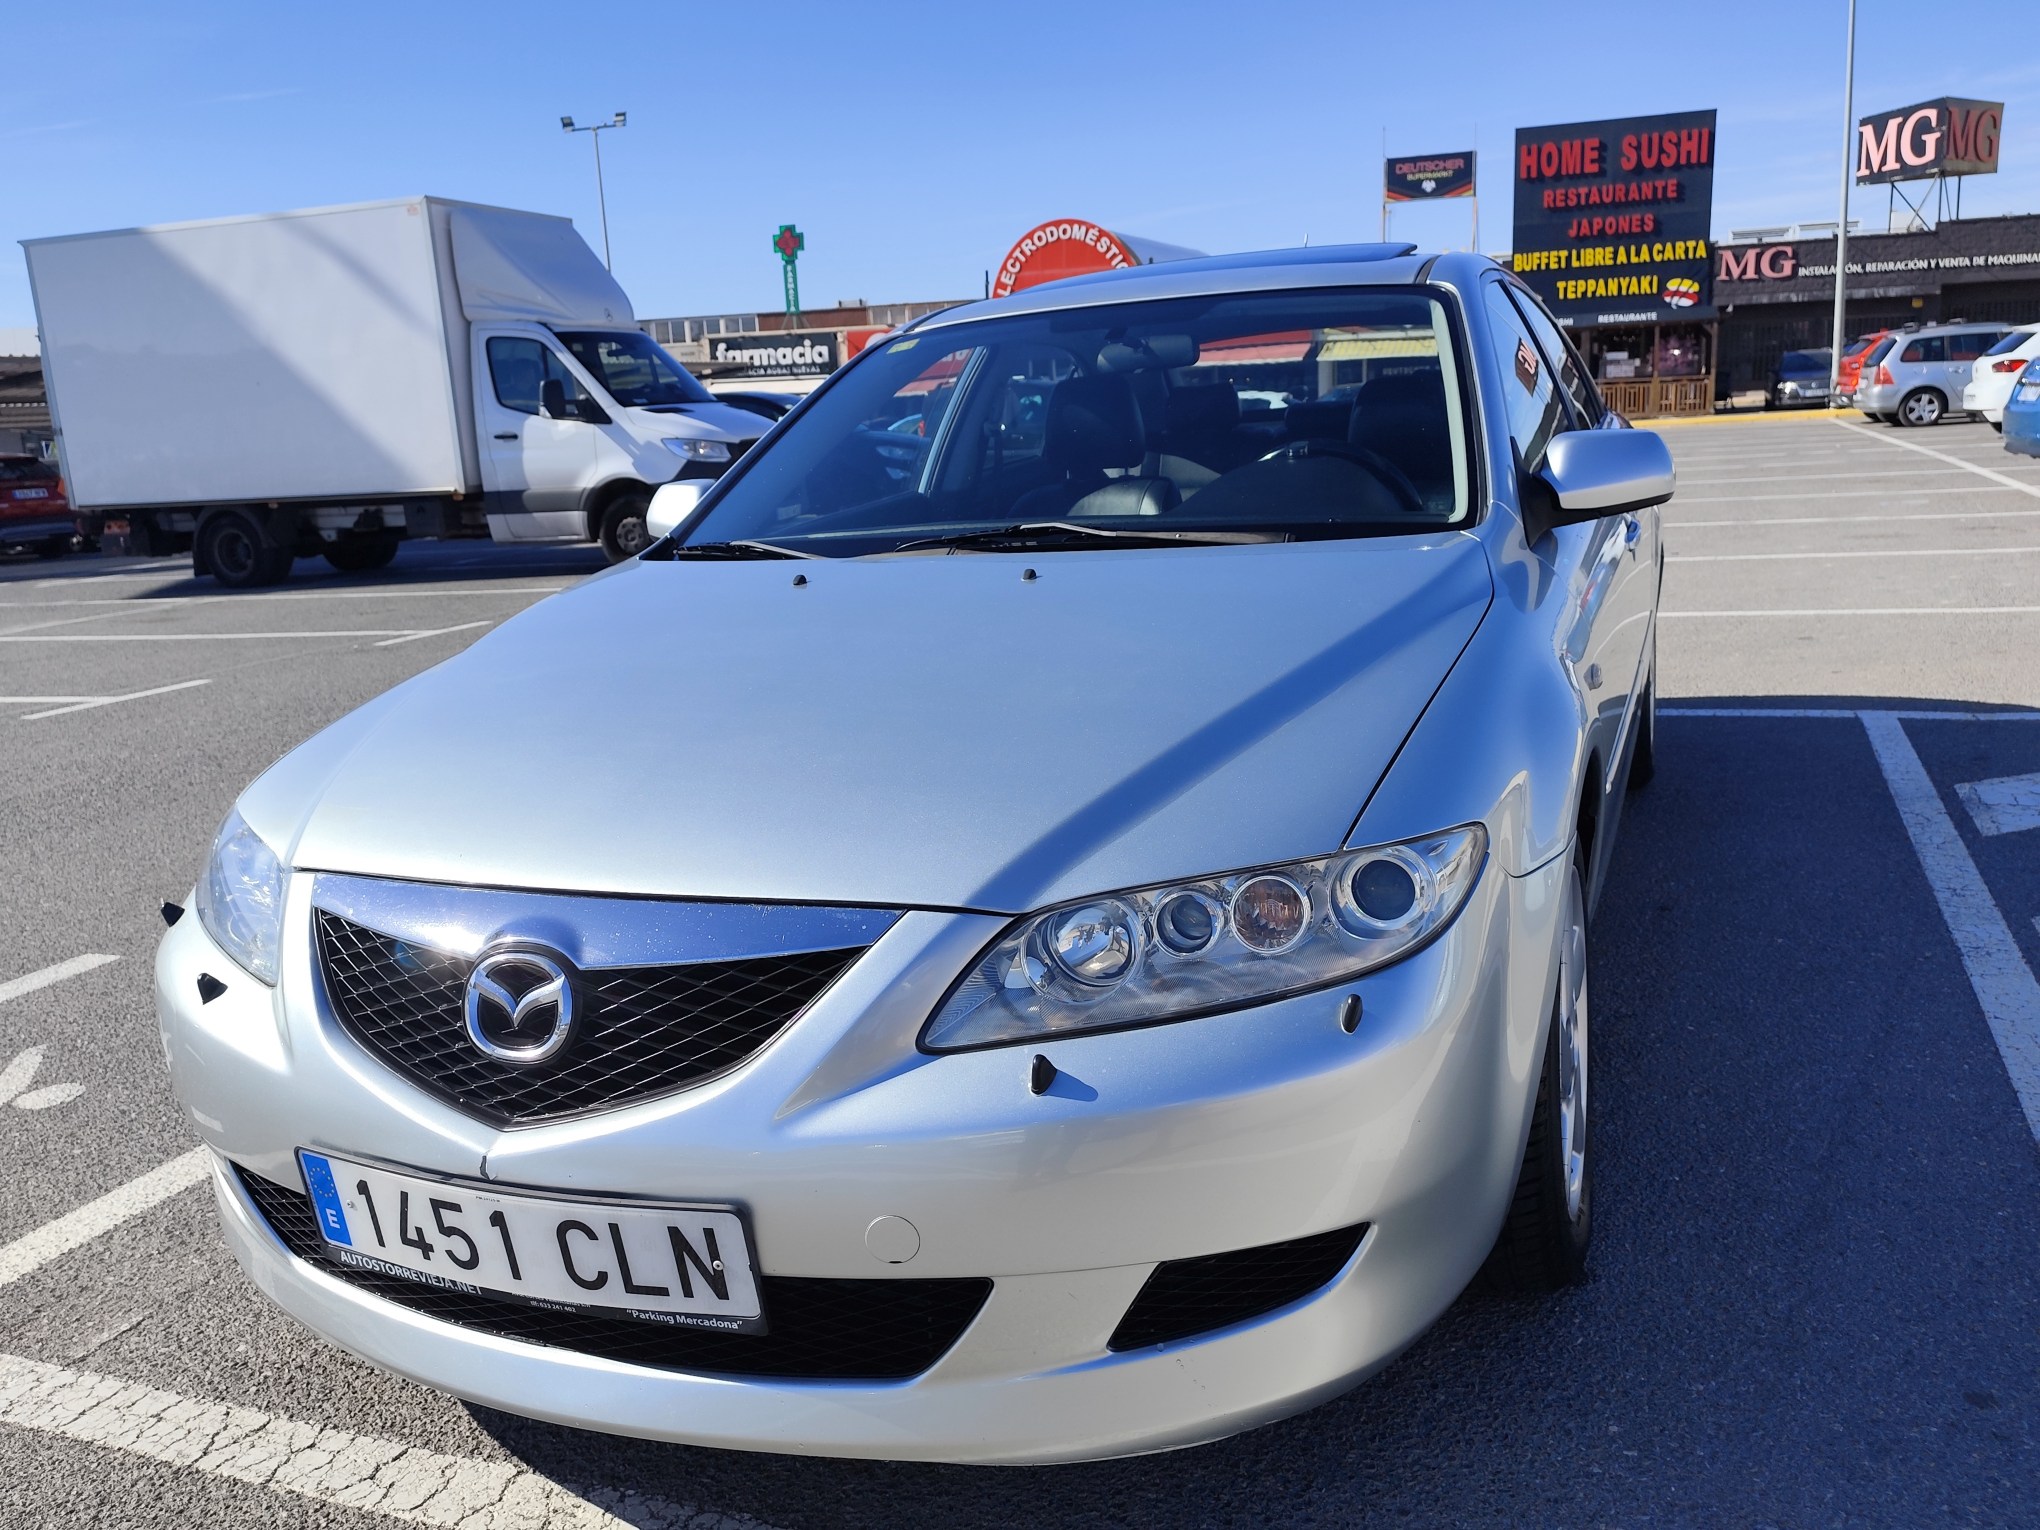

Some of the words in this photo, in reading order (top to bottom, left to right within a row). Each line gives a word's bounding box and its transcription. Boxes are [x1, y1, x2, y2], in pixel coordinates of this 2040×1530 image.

[1855, 107, 1942, 178] MG
[1945, 106, 2001, 164] MG
[1395, 158, 1464, 175] DEUTSCHER
[1519, 137, 1600, 180] HOME
[1620, 127, 1710, 171] SUSHI
[1542, 177, 1678, 209] RESTAURANTE
[1567, 213, 1655, 238] JAPONES
[1513, 249, 1569, 272] BUFFET
[1571, 245, 1615, 268] LIBRE
[1616, 244, 1628, 265] A
[1630, 242, 1651, 264] LA
[1652, 238, 1707, 262] CARTA
[1715, 245, 1797, 281] MG
[1798, 261, 1863, 277] INSTALAÓN,
[1865, 257, 1929, 273] REPARACIÓN
[1929, 258, 1938, 269] Y
[1938, 256, 1970, 268] VENTA
[1973, 254, 1986, 266] DE
[1987, 252, 2040, 266] MAQUINA
[1556, 274, 1659, 300] TEPPANYAKI
[1597, 311, 1658, 324] RESTAURANTE
[716, 338, 829, 366] farmacia
[326, 1208, 340, 1228] E
[356, 1179, 522, 1281] 1451
[556, 1219, 730, 1300] CLN
